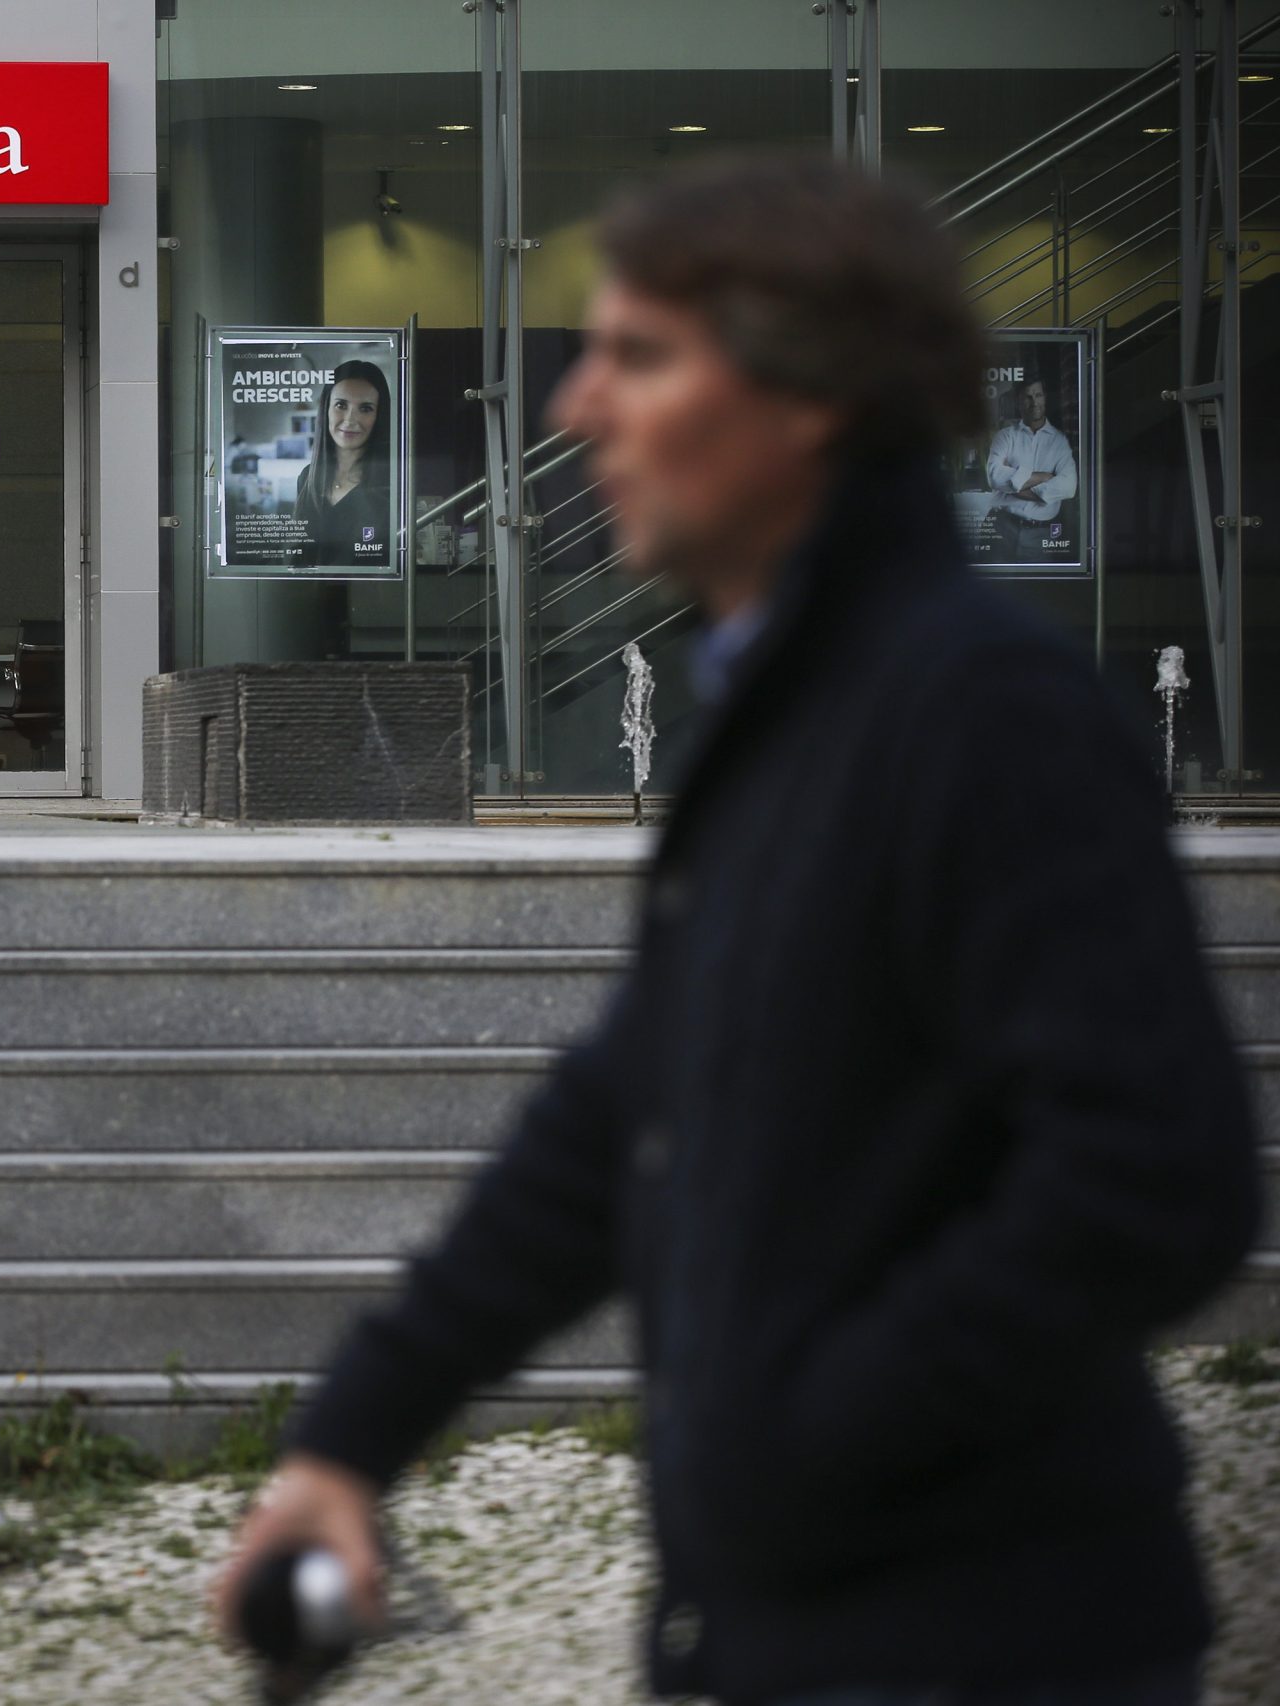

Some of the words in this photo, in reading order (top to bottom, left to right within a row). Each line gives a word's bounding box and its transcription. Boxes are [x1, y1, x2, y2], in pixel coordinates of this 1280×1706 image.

[118, 261, 140, 289] d
[232, 370, 335, 385] AMBICIONE
[232, 387, 313, 403] CRESCER
[354, 542, 383, 552] BANIF
[1041, 539, 1071, 548] BANIF
